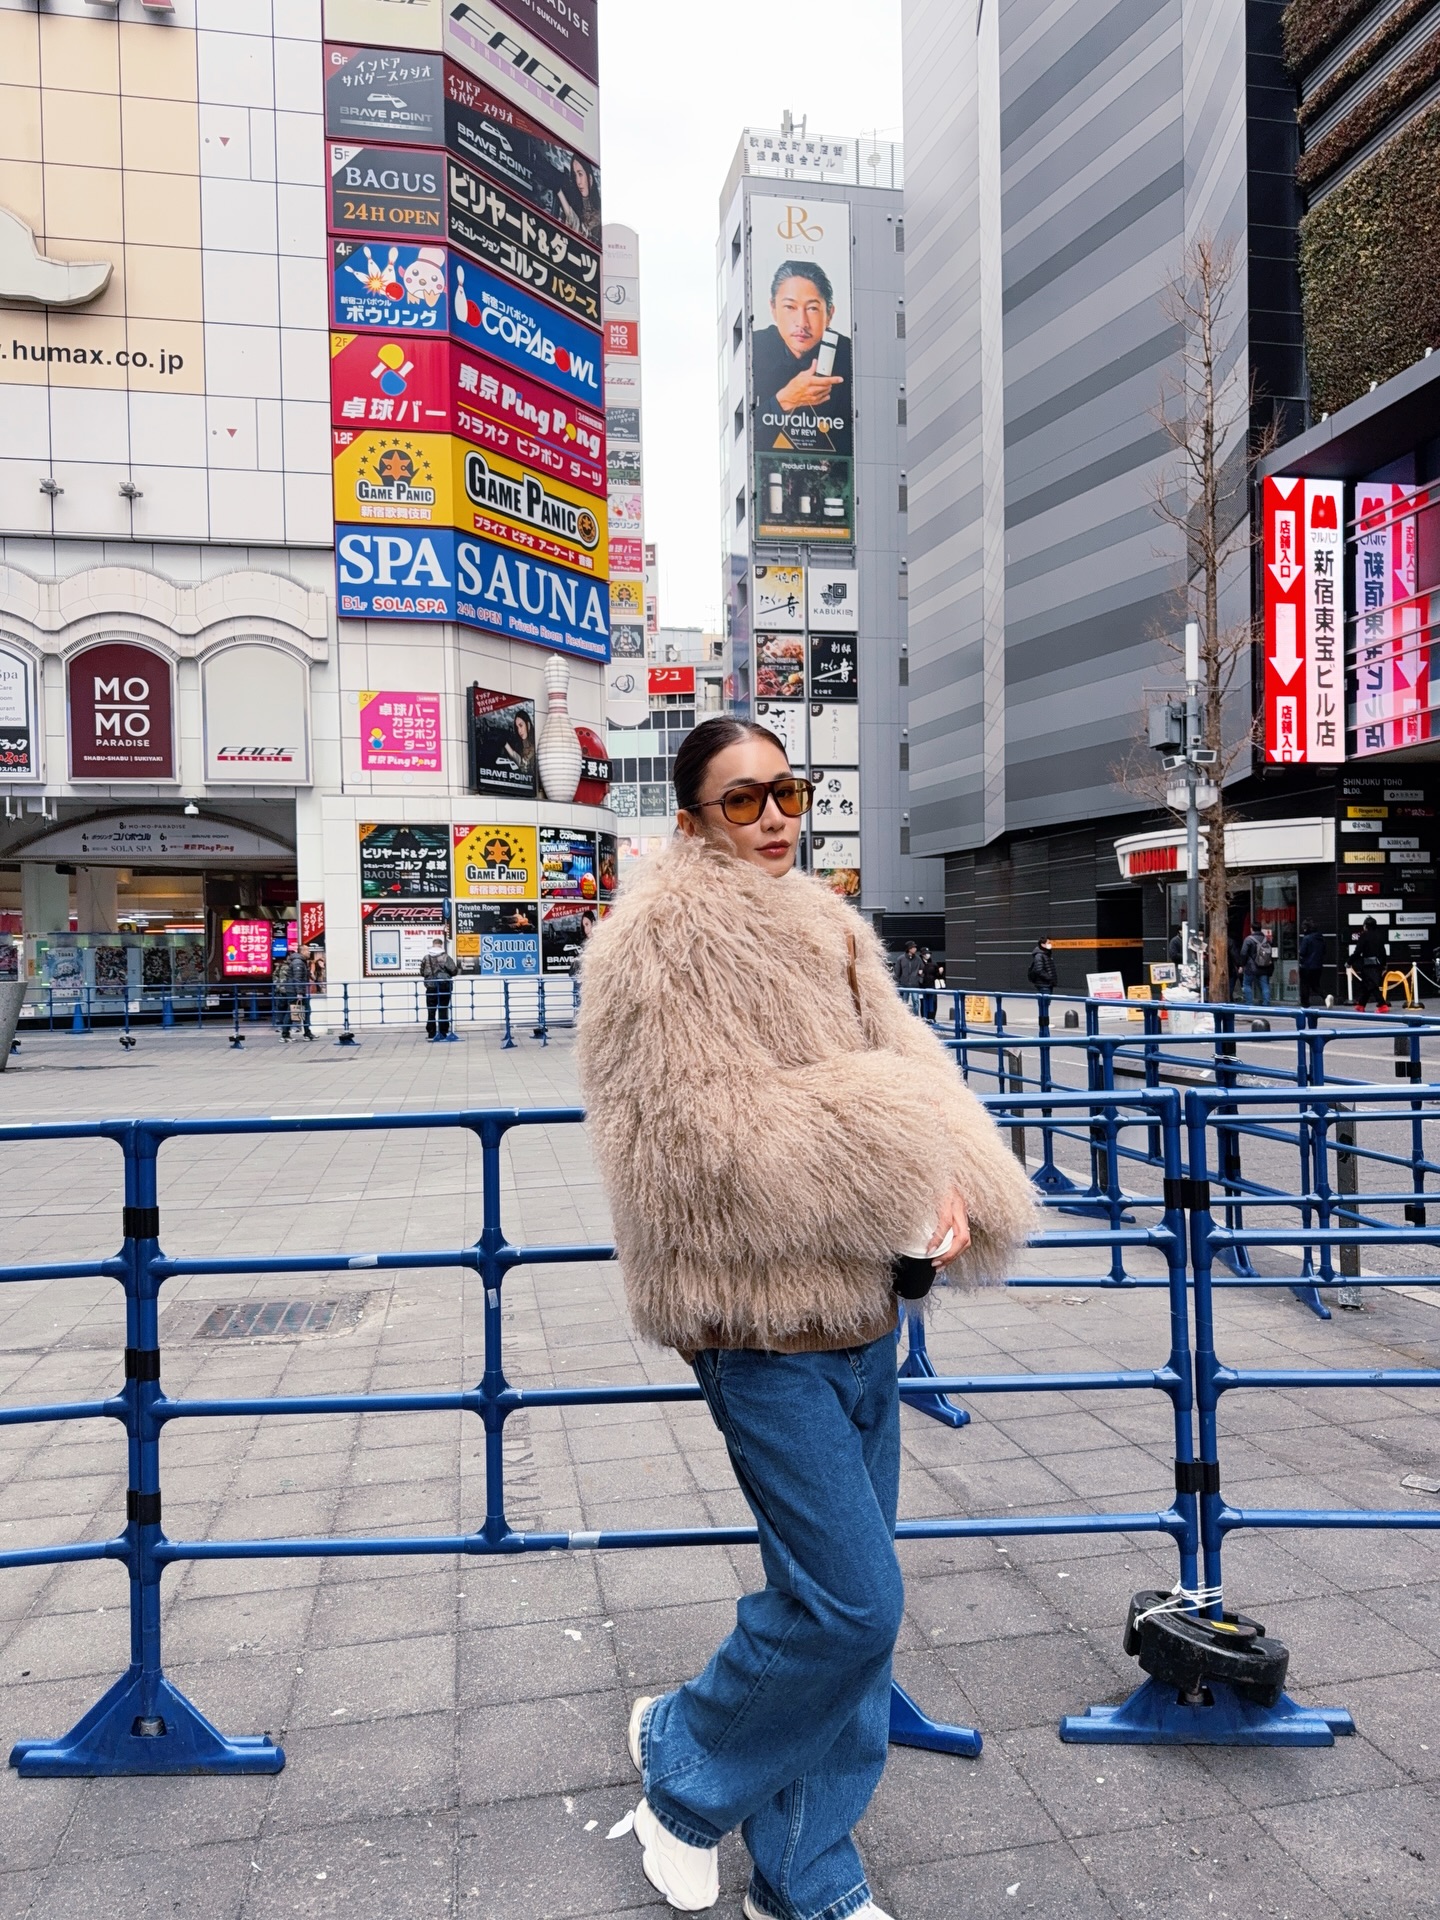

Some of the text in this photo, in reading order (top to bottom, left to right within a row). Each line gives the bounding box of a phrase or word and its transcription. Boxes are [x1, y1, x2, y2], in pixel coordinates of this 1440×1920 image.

[537, 6, 569, 38] SUKIYAKI
[331, 52, 348, 65] 6F
[356, 57, 401, 73] インドア
[450, 2, 594, 118] FACE
[342, 65, 431, 87] サバゲースタジオ
[448, 75, 481, 97] インドア
[450, 87, 513, 124] サバゲースタジオ
[340, 106, 387, 119] BRAVE
[391, 110, 433, 122] POINT
[334, 148, 350, 161] 5F
[458, 121, 497, 157] BRAVE
[499, 150, 533, 179] POINT
[345, 166, 437, 194] BAGUS
[343, 201, 440, 226] 24H OPEN
[450, 166, 597, 283] ビリヤード&ダーツ
[335, 243, 352, 256] 4F
[785, 243, 816, 255] REVI
[340, 295, 392, 307] 新宿コパボウル
[552, 276, 598, 319] バグース
[346, 305, 438, 327] ボウリング
[481, 291, 536, 329] 新宿コパボウル
[610, 325, 628, 334] MO
[334, 336, 348, 348] 2F
[482, 306, 599, 389] COPABOWL
[610, 337, 628, 346] MO
[0, 339, 184, 375] .humax.co.jp
[458, 363, 500, 404] 東京
[501, 383, 550, 435] Ping
[341, 396, 447, 423] 卓球バー
[762, 412, 845, 430] auralume
[790, 428, 817, 437] BY REVI
[457, 410, 603, 487] カラオケ ビアボン ダーツ
[617, 451, 640, 460] ダーツ
[781, 462, 828, 472] Product Lineup
[358, 480, 432, 502] GAME PANIC
[467, 455, 578, 534] GAME PANIC
[360, 505, 433, 520] 新宿歌舞伎町
[608, 521, 640, 530] ボウリング
[474, 516, 575, 562] プライズ ビデオ アーケード
[1310, 532, 1338, 544] マルハン
[1280, 520, 1291, 578] 店舗入口
[339, 534, 451, 587] SPA
[457, 543, 609, 635] SAUNA
[342, 596, 447, 613] B1F SOLA SPA
[457, 601, 607, 655] 24h OPEN Private Room Restaurant
[811, 638, 820, 646] 7F
[1314, 549, 1336, 748] 新宿東宝ビル店
[94, 676, 150, 702] MO
[362, 693, 373, 702] 2F
[378, 702, 435, 717] 卓球バー
[94, 712, 151, 737] MO
[392, 717, 436, 728] カラオケ
[392, 728, 436, 740] ビアボン
[95, 739, 150, 747] PARADISE
[403, 739, 437, 751] ダーツ
[218, 746, 299, 756] FACE
[387, 755, 411, 768] Ping
[479, 767, 533, 782] BRAVE POINT
[1343, 778, 1403, 786] SHINJUKU TOHO
[113, 832, 152, 841] コパボウル
[361, 825, 371, 834] 5F
[540, 829, 555, 838] 4F
[110, 845, 153, 853] SOLA SPA
[541, 844, 569, 852] BOWLING
[814, 839, 822, 847] 1F
[362, 847, 447, 859] ビリヤード&ダーツ
[425, 860, 447, 871] 卓球
[467, 865, 526, 880] GAME PANIC
[363, 870, 401, 879] BAGUS
[468, 884, 525, 895] 新宿歌舞伎町
[1357, 884, 1374, 892] KFC
[363, 904, 373, 913] 7F
[316, 904, 324, 929] インドア
[457, 919, 474, 927] 24h
[231, 924, 268, 935] 卓球バー
[240, 935, 268, 944] カラオケ
[482, 936, 537, 953] Sauna
[247, 952, 268, 961] ダーツ
[482, 953, 516, 974] Spa
